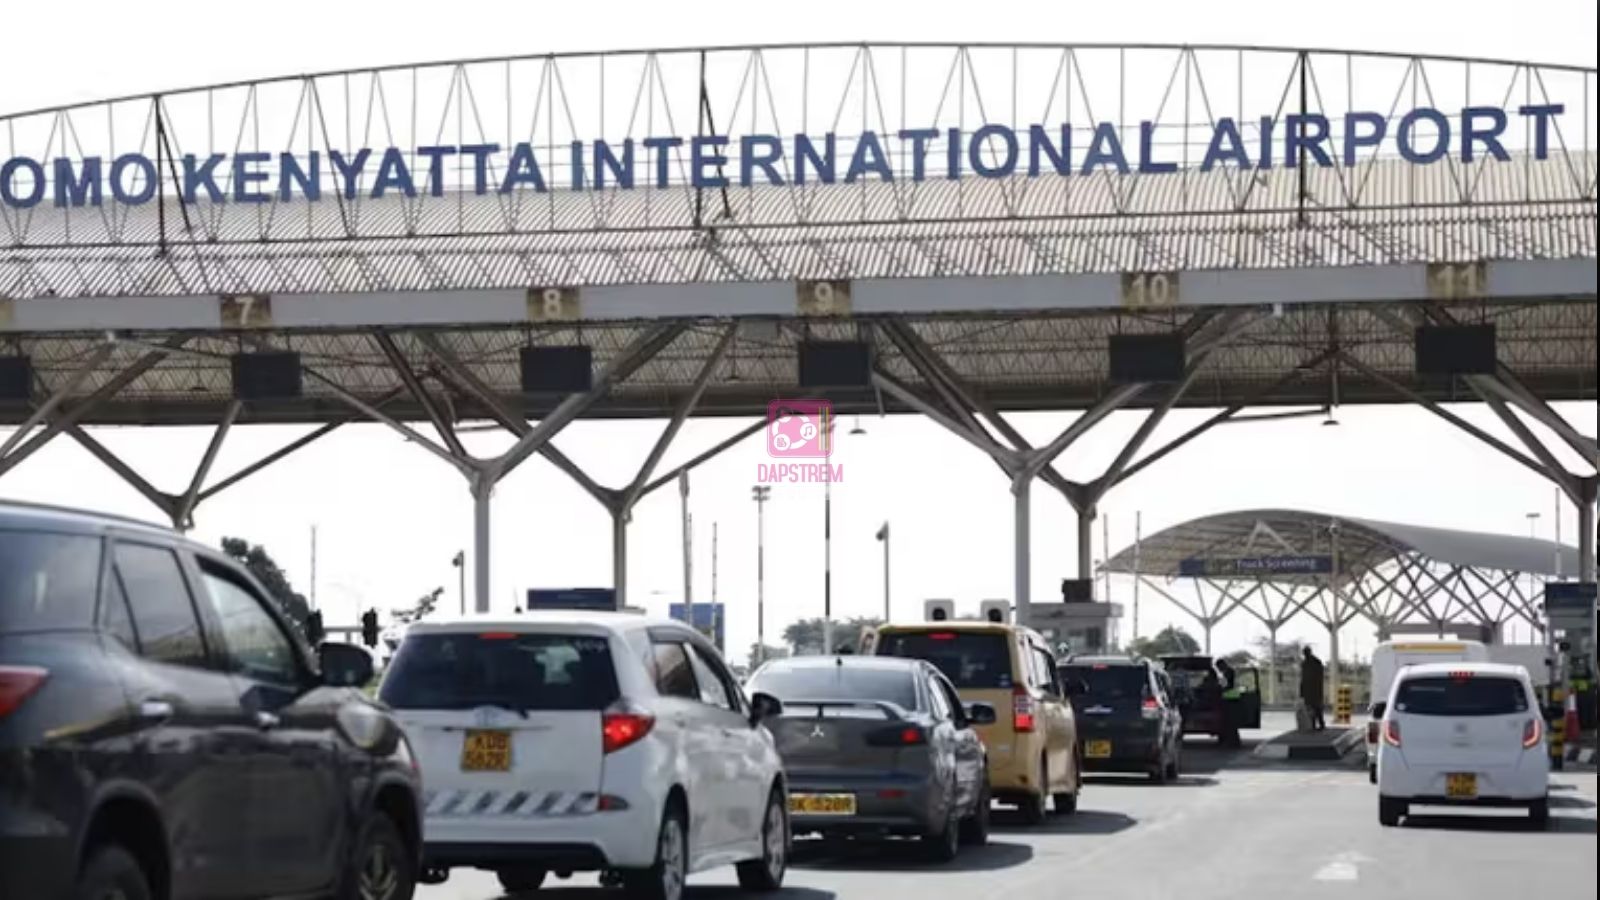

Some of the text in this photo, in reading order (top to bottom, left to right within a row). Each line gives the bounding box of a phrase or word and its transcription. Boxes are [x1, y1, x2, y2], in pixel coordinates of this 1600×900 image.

[0, 103, 1565, 208] OMO KENYATTA INTERNATIONAL AIRPORT
[1131, 274, 1170, 303] 10
[1435, 265, 1486, 296] 11
[234, 296, 254, 325] 7
[541, 289, 562, 317] 8
[813, 282, 835, 313] 9
[1236, 558, 1317, 569] Truck Screening
